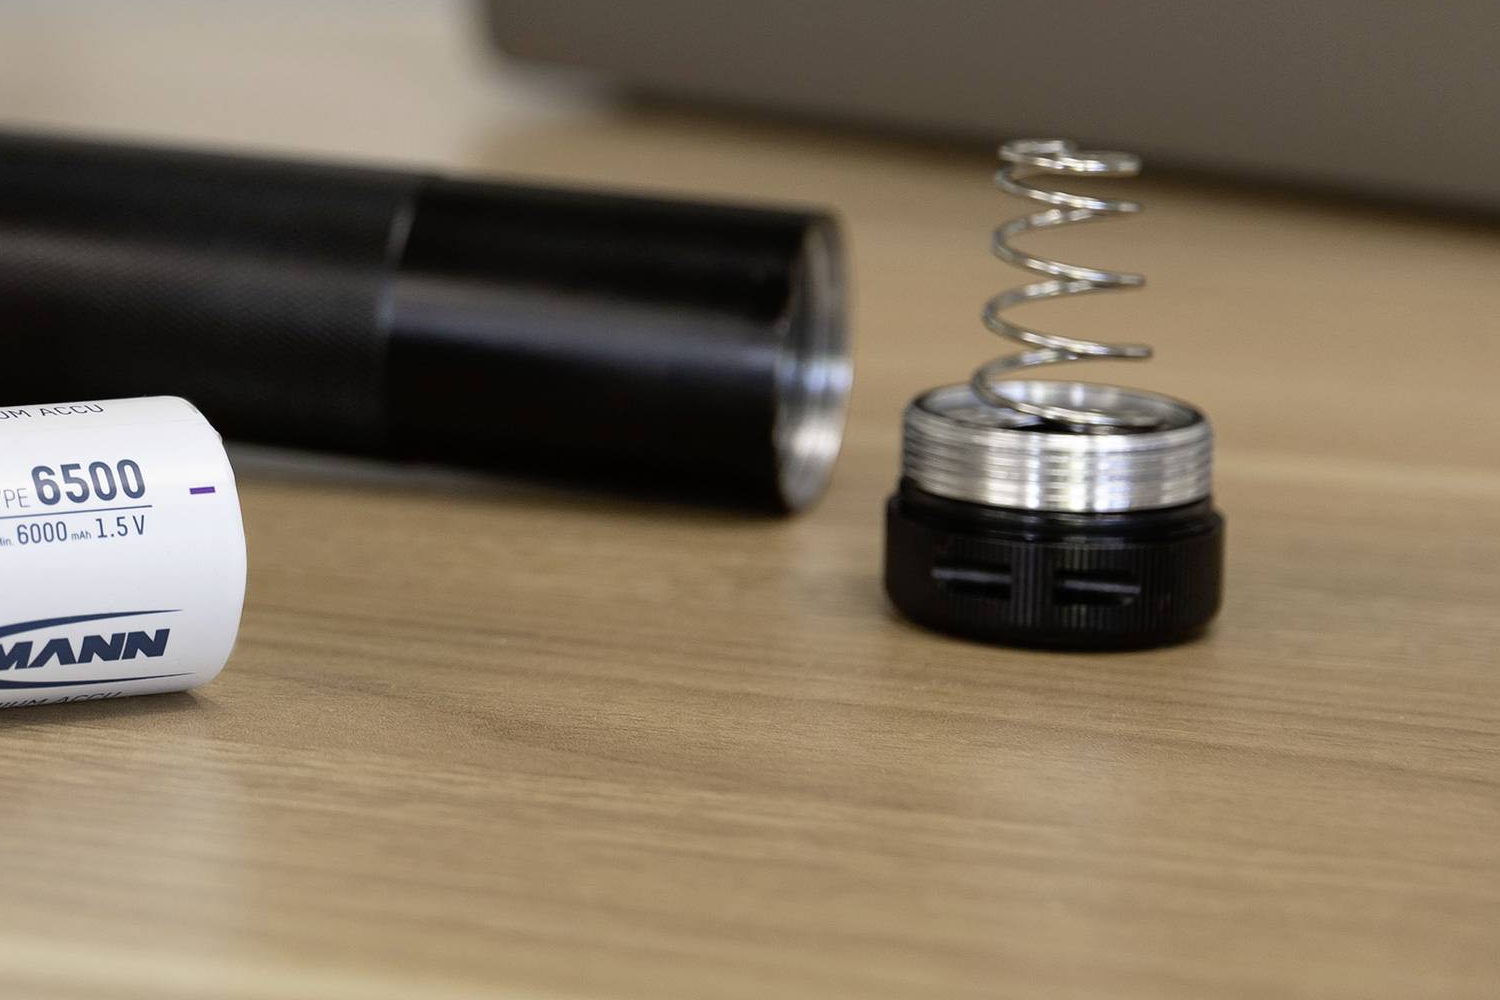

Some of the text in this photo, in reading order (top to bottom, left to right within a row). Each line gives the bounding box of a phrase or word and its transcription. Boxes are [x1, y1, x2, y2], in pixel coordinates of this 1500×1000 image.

[39, 404, 105, 417] ACCU
[31, 459, 146, 506] 6500
[16, 521, 68, 545] 6000
[71, 531, 92, 541] mAh
[96, 516, 129, 539] 1.5
[132, 515, 146, 536] V
